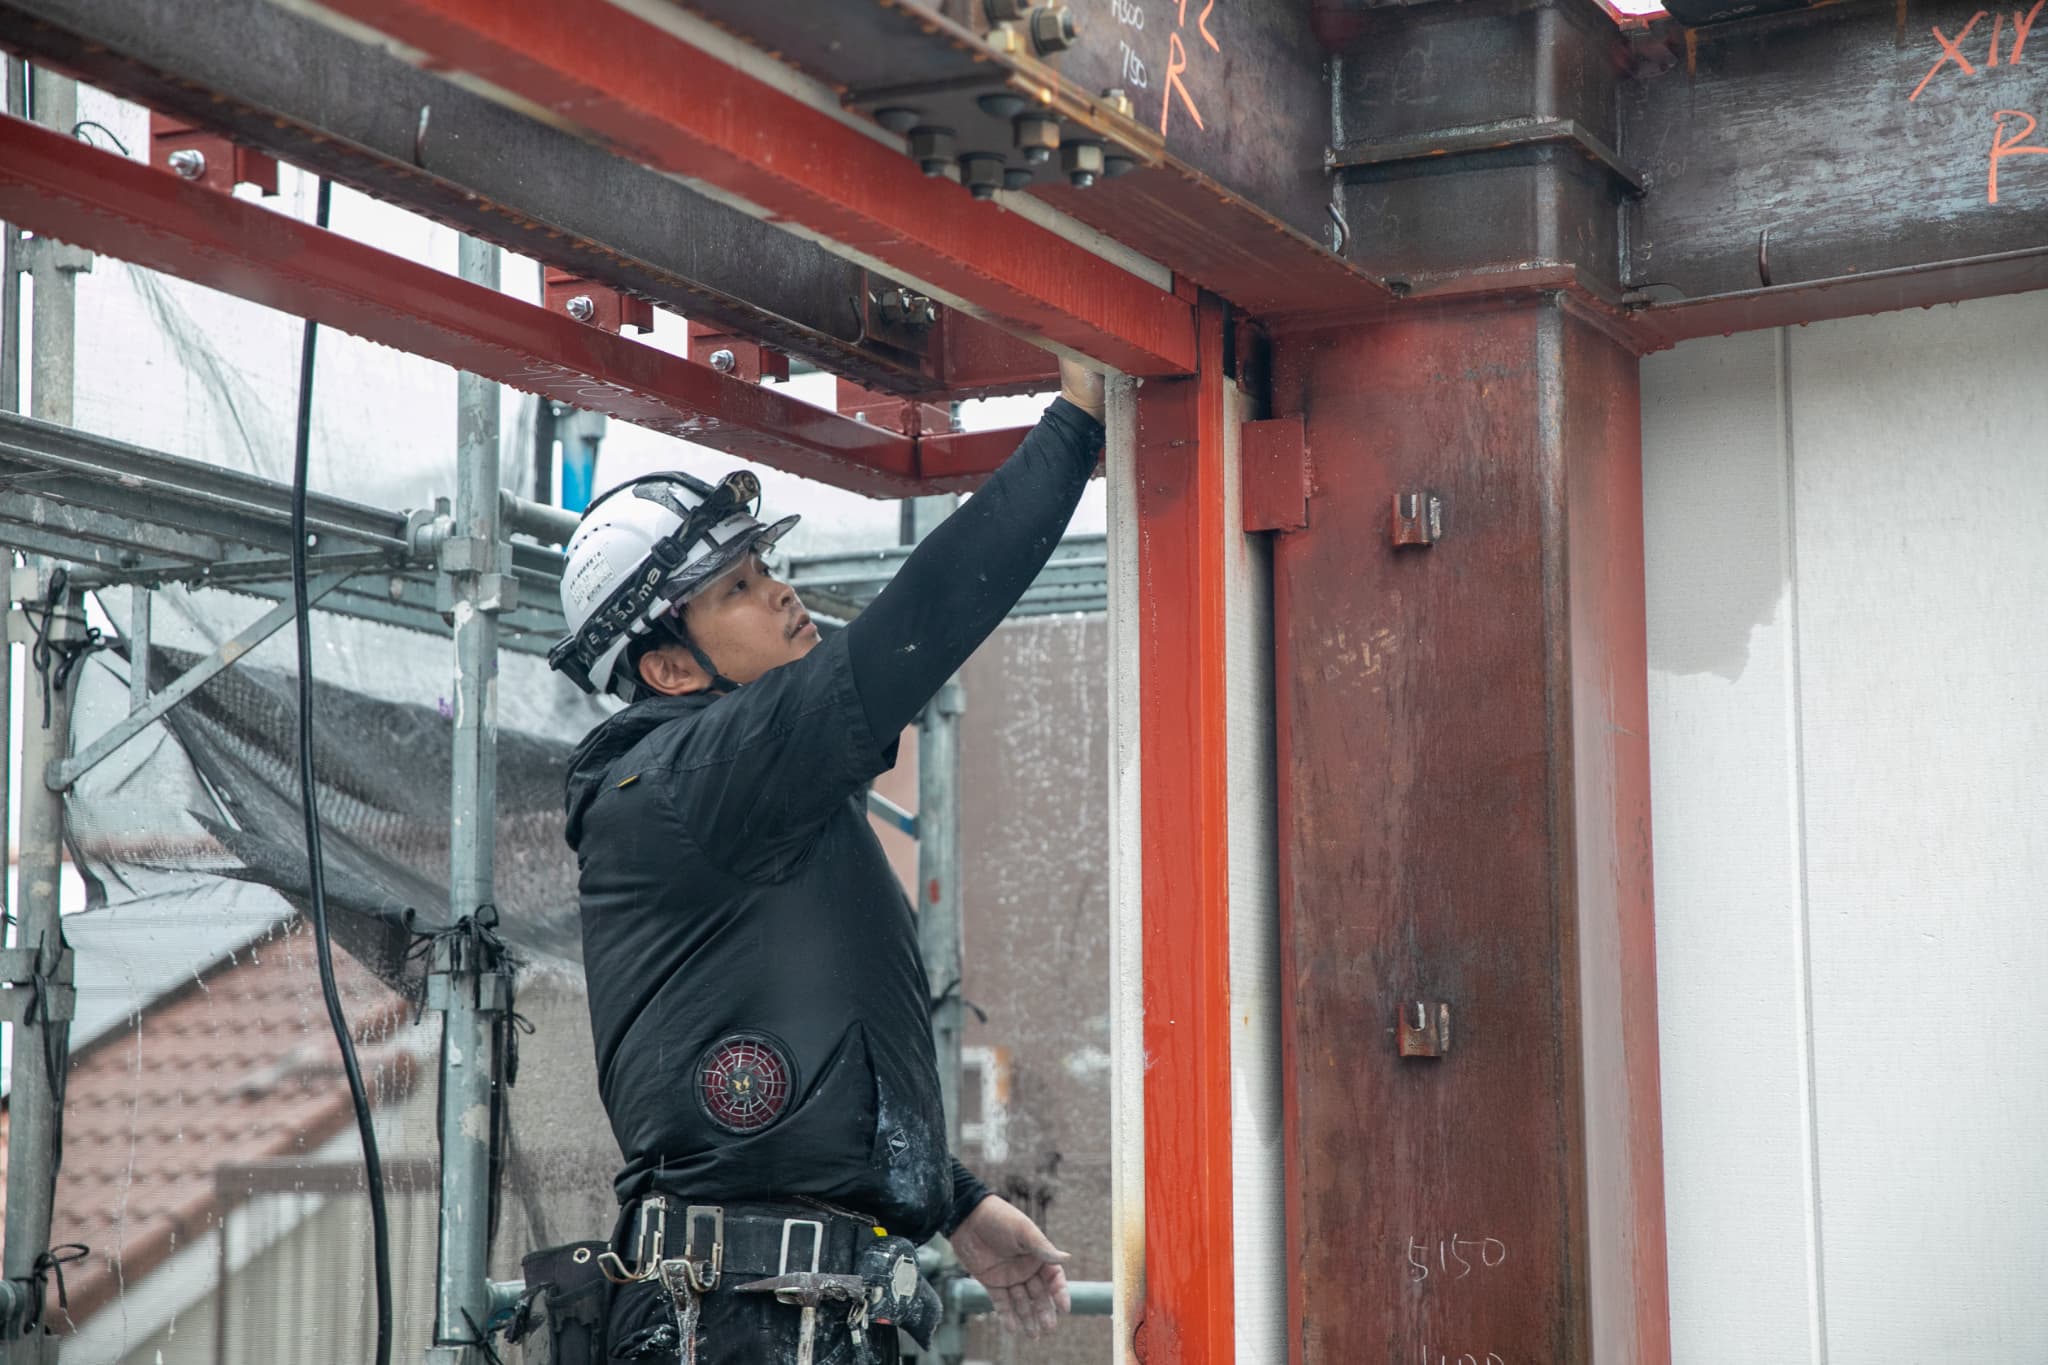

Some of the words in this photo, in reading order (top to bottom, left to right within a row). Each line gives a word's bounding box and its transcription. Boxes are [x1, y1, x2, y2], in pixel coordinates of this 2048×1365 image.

[1160, 31, 1205, 137] R
[1987, 109, 2048, 205] R
[1407, 1232, 1506, 1283] 5150
